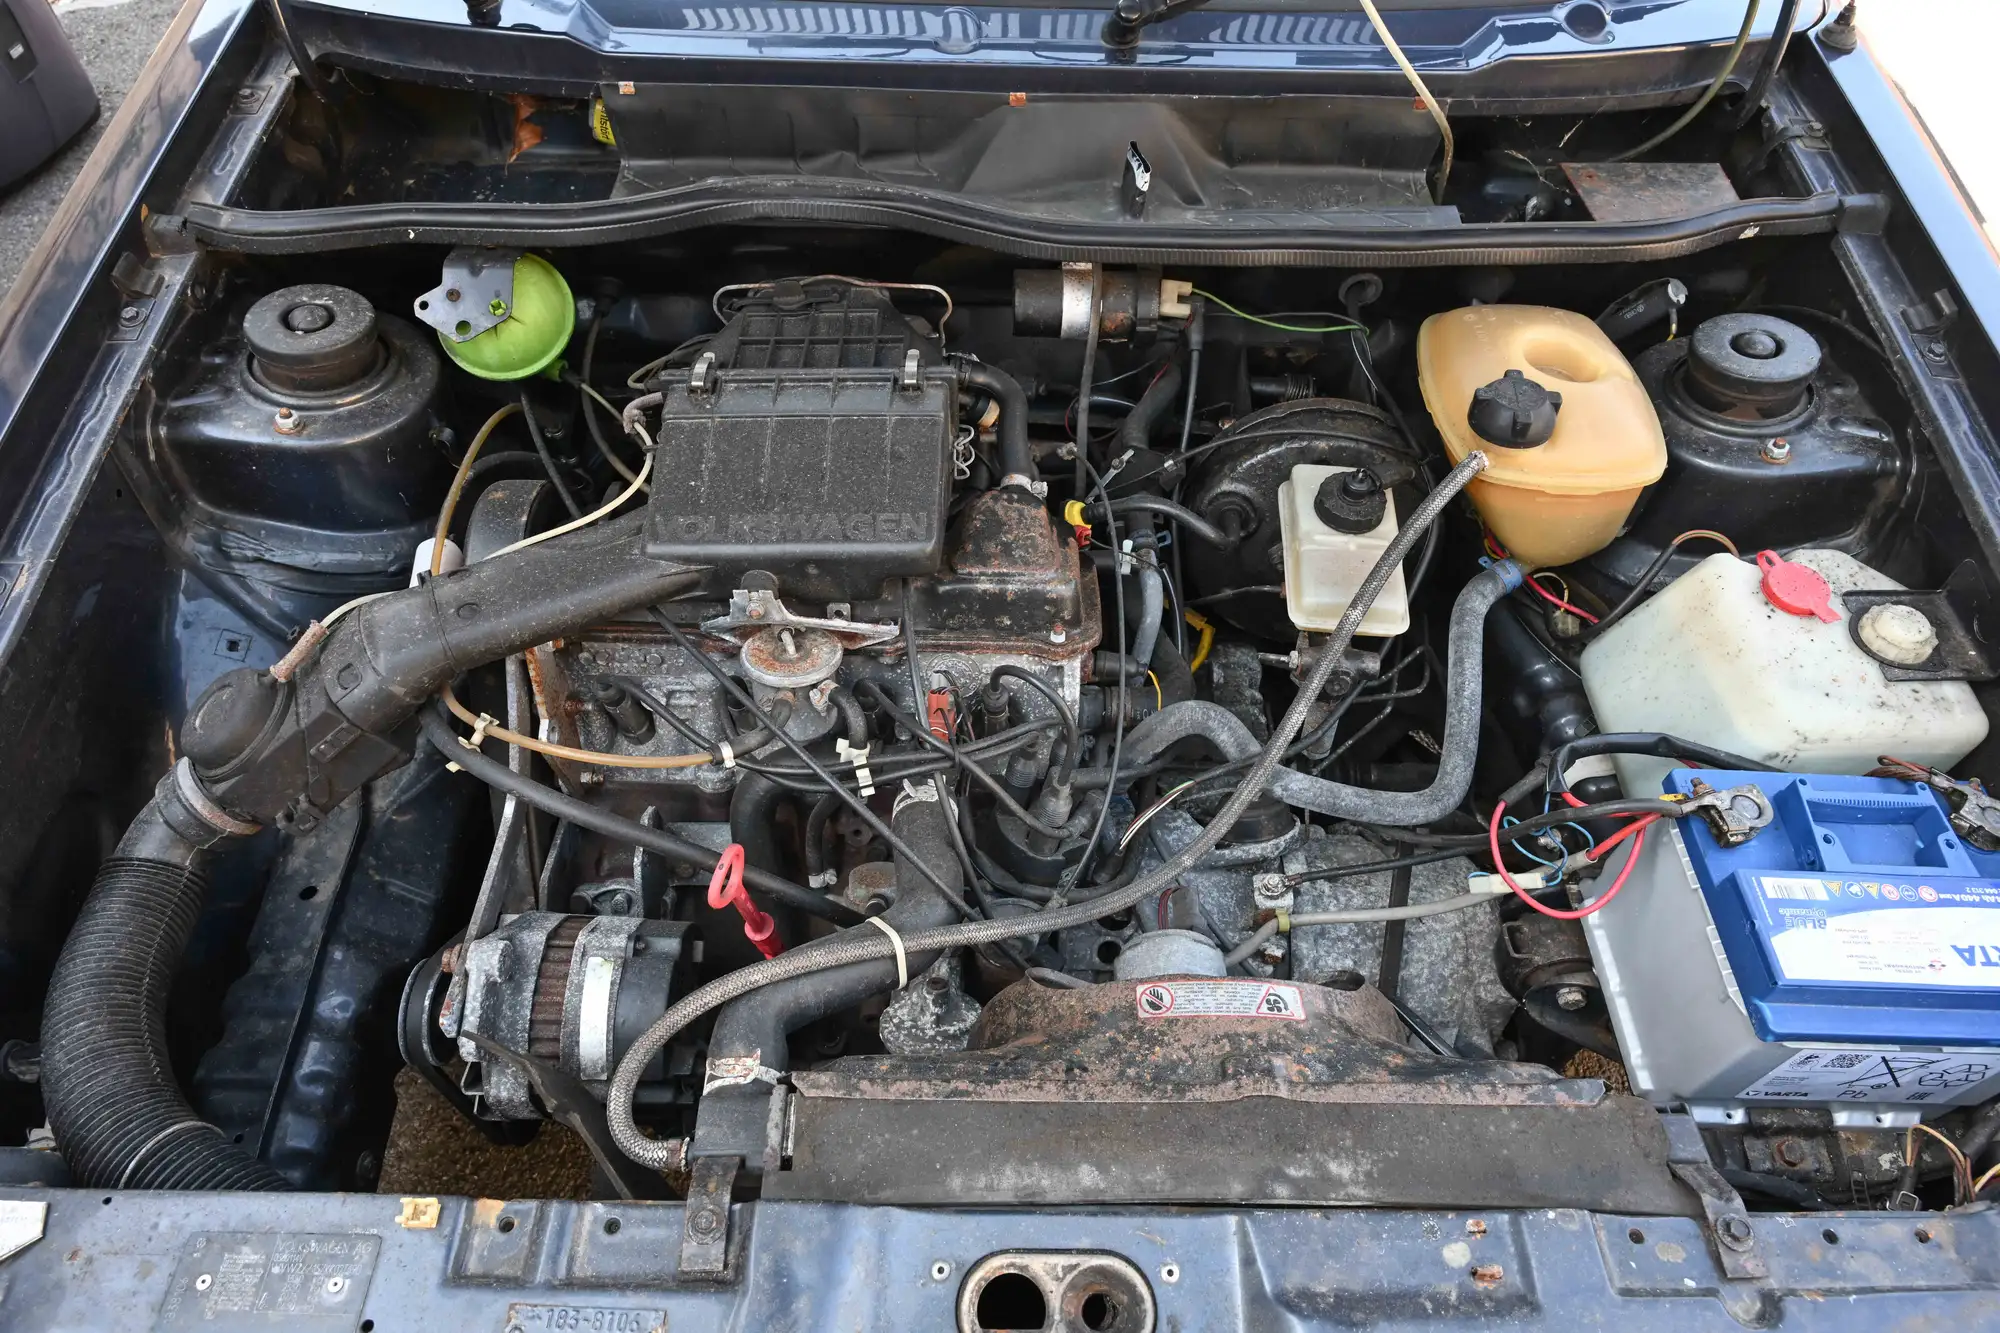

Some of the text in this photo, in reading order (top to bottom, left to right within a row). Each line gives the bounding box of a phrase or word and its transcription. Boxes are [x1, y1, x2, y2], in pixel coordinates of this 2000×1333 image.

[655, 512, 929, 540] VOLKSWAGEN
[1778, 907, 1827, 918] Dynamic
[1784, 916, 1827, 930] BLUE
[1836, 1089, 1868, 1099] Pb
[276, 1240, 373, 1256] VOLKSWAGEN AG
